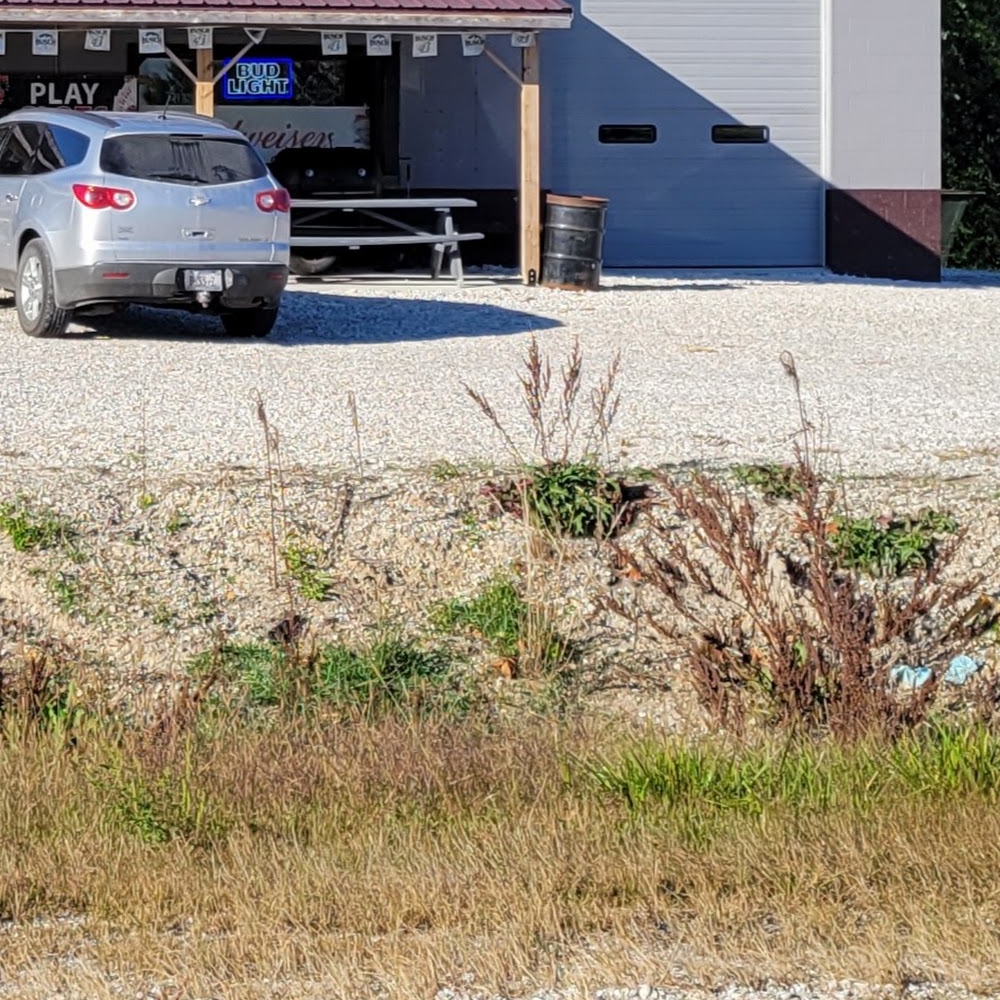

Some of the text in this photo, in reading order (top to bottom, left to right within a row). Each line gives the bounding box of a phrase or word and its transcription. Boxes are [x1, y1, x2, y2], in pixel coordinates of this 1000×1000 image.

[236, 62, 281, 79] BUD
[30, 82, 100, 105] PLAY
[228, 78, 289, 95] LIGHT
